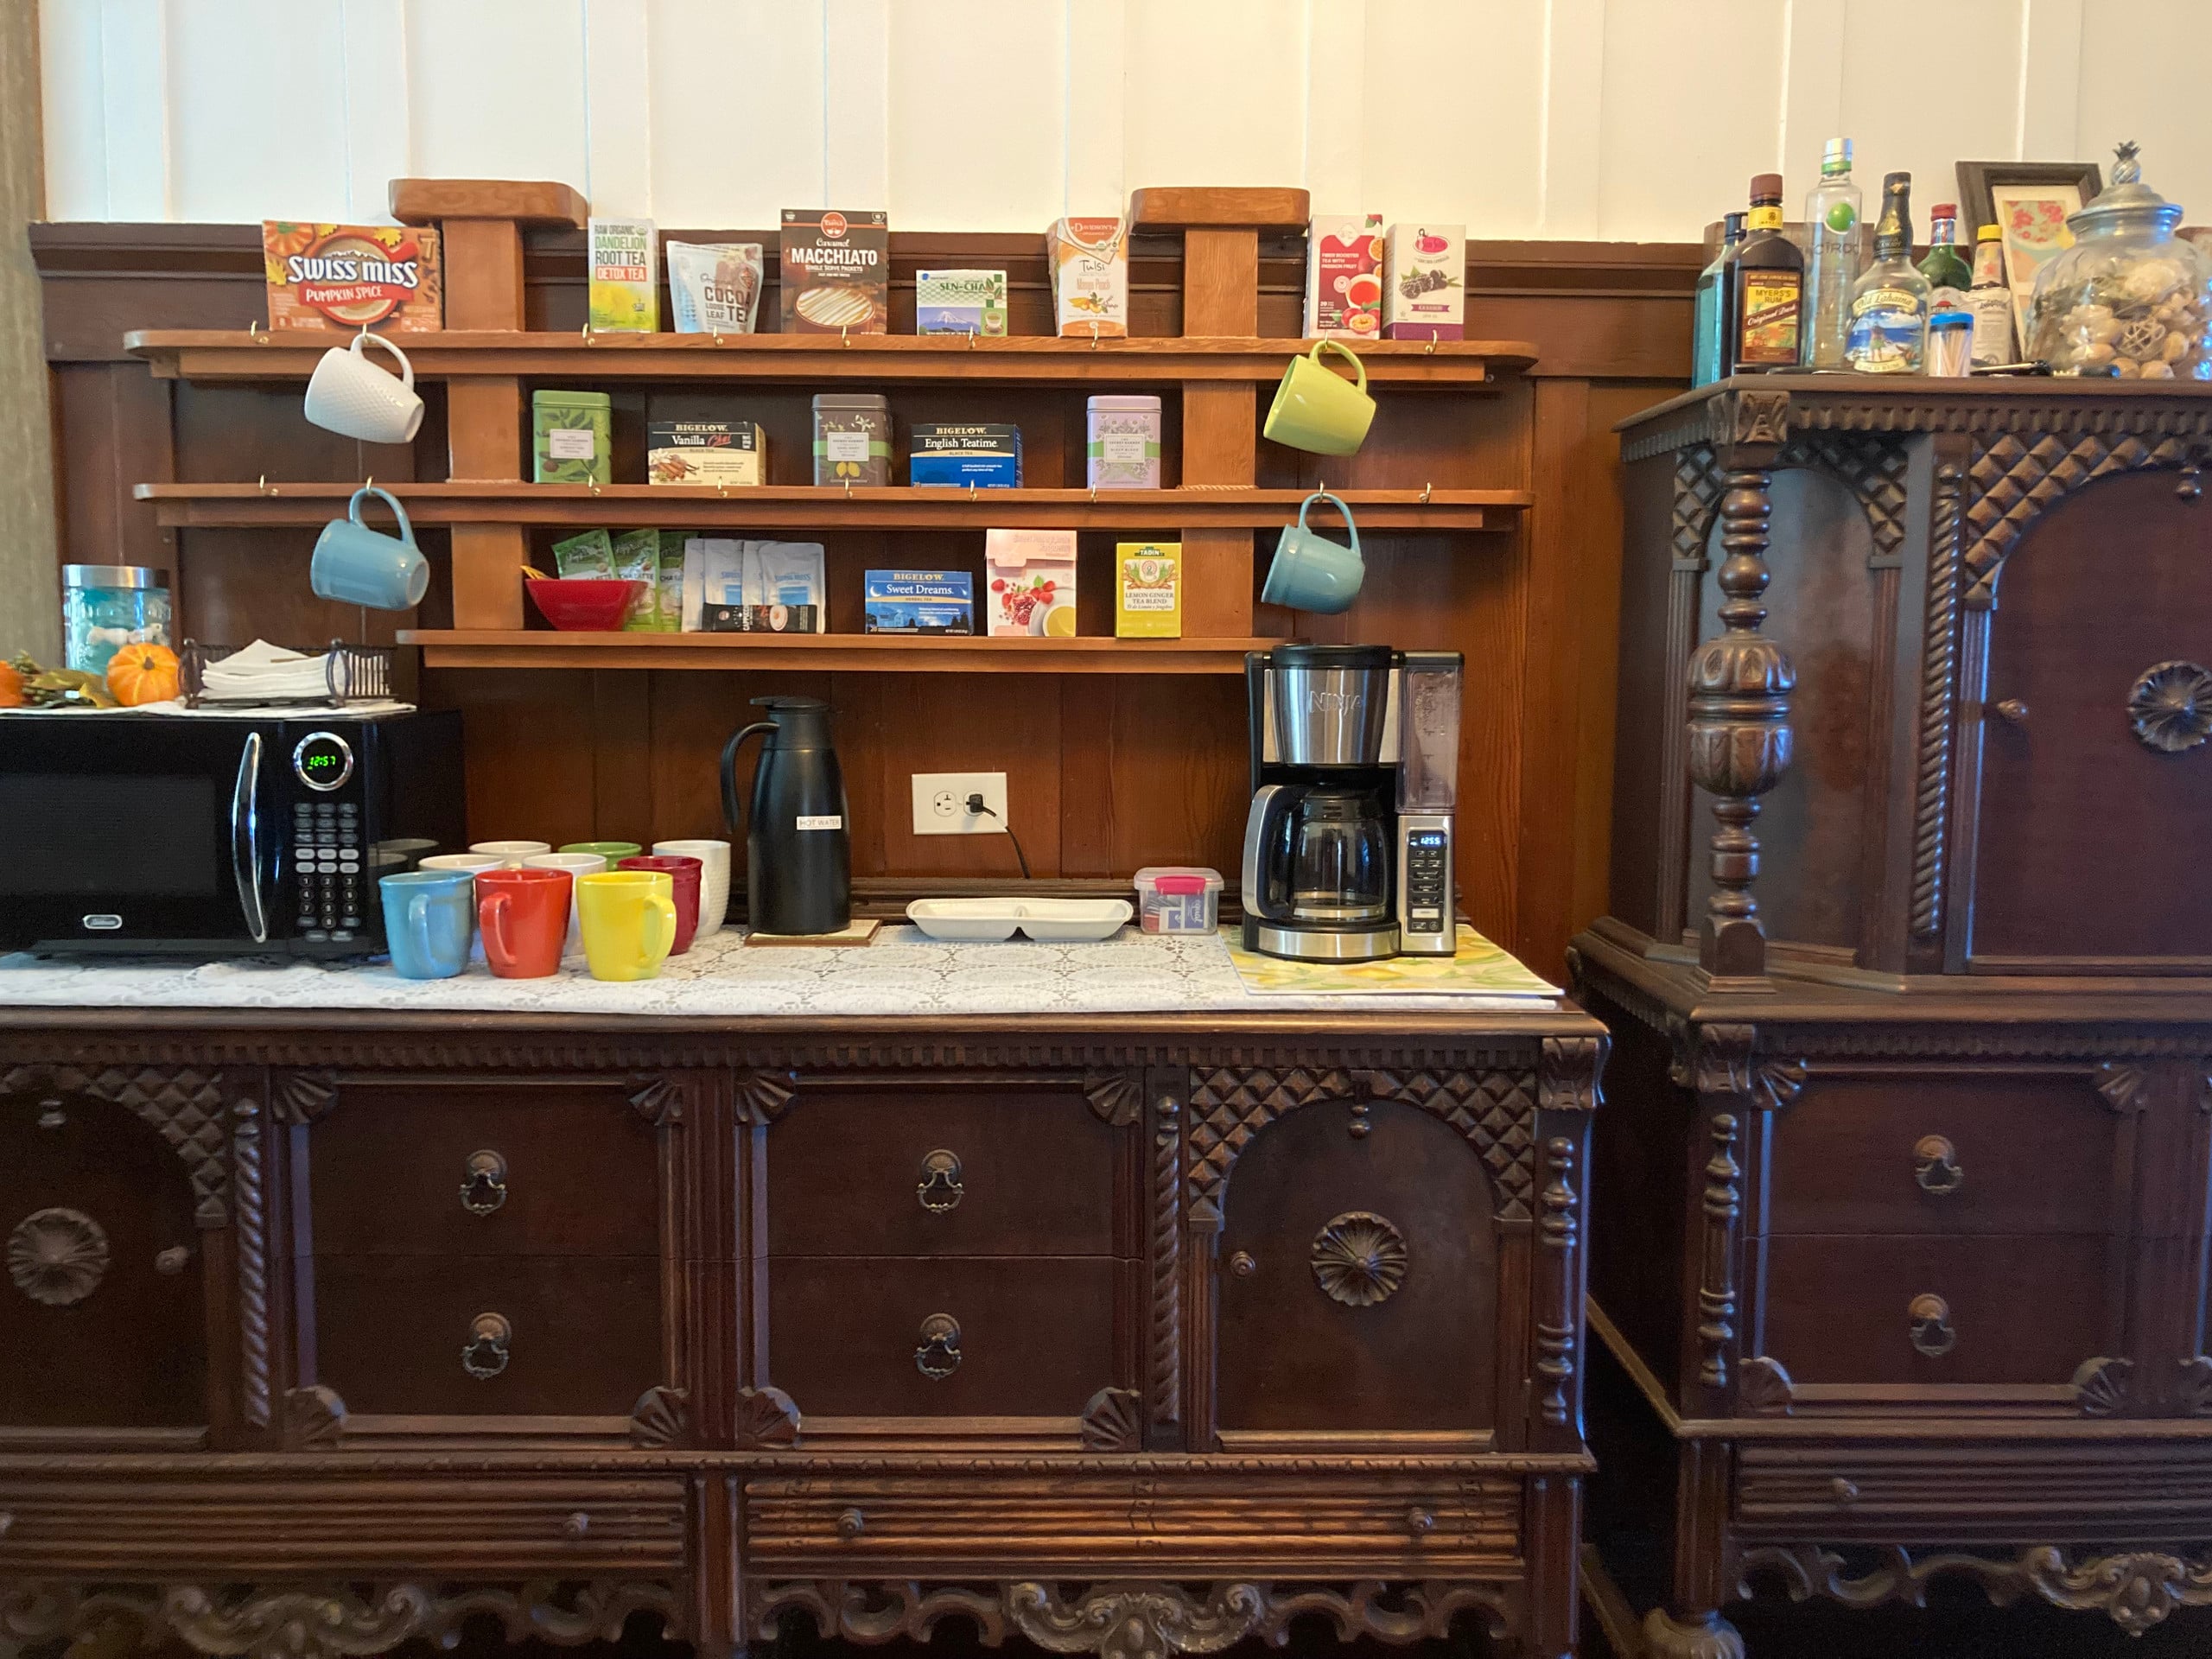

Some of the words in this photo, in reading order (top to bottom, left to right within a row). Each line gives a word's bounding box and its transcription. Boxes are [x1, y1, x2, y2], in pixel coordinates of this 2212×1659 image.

[609, 225, 635, 235] ORGANIC
[594, 236, 647, 250] DANDELION
[816, 238, 850, 247] Caramel
[595, 251, 622, 264] ROOT
[625, 251, 646, 265] TEA
[791, 248, 878, 266] MACCHIATO
[1078, 260, 1105, 272] Tulsi
[597, 267, 626, 280] DETOX
[627, 268, 645, 280] TEA
[940, 283, 986, 291] SEN-CHA
[306, 288, 354, 303] PUMPKIN
[355, 286, 383, 299] SPICE
[706, 310, 726, 320] LEAF
[1747, 309, 1778, 327] Original
[1778, 303, 1796, 316] Dark
[671, 435, 705, 445] Vanilla
[925, 438, 959, 450] English
[886, 584, 913, 594] Sweet
[1310, 690, 1363, 716] NINJA
[310, 755, 336, 766] 12:57
[1192, 899, 1203, 923] equal
